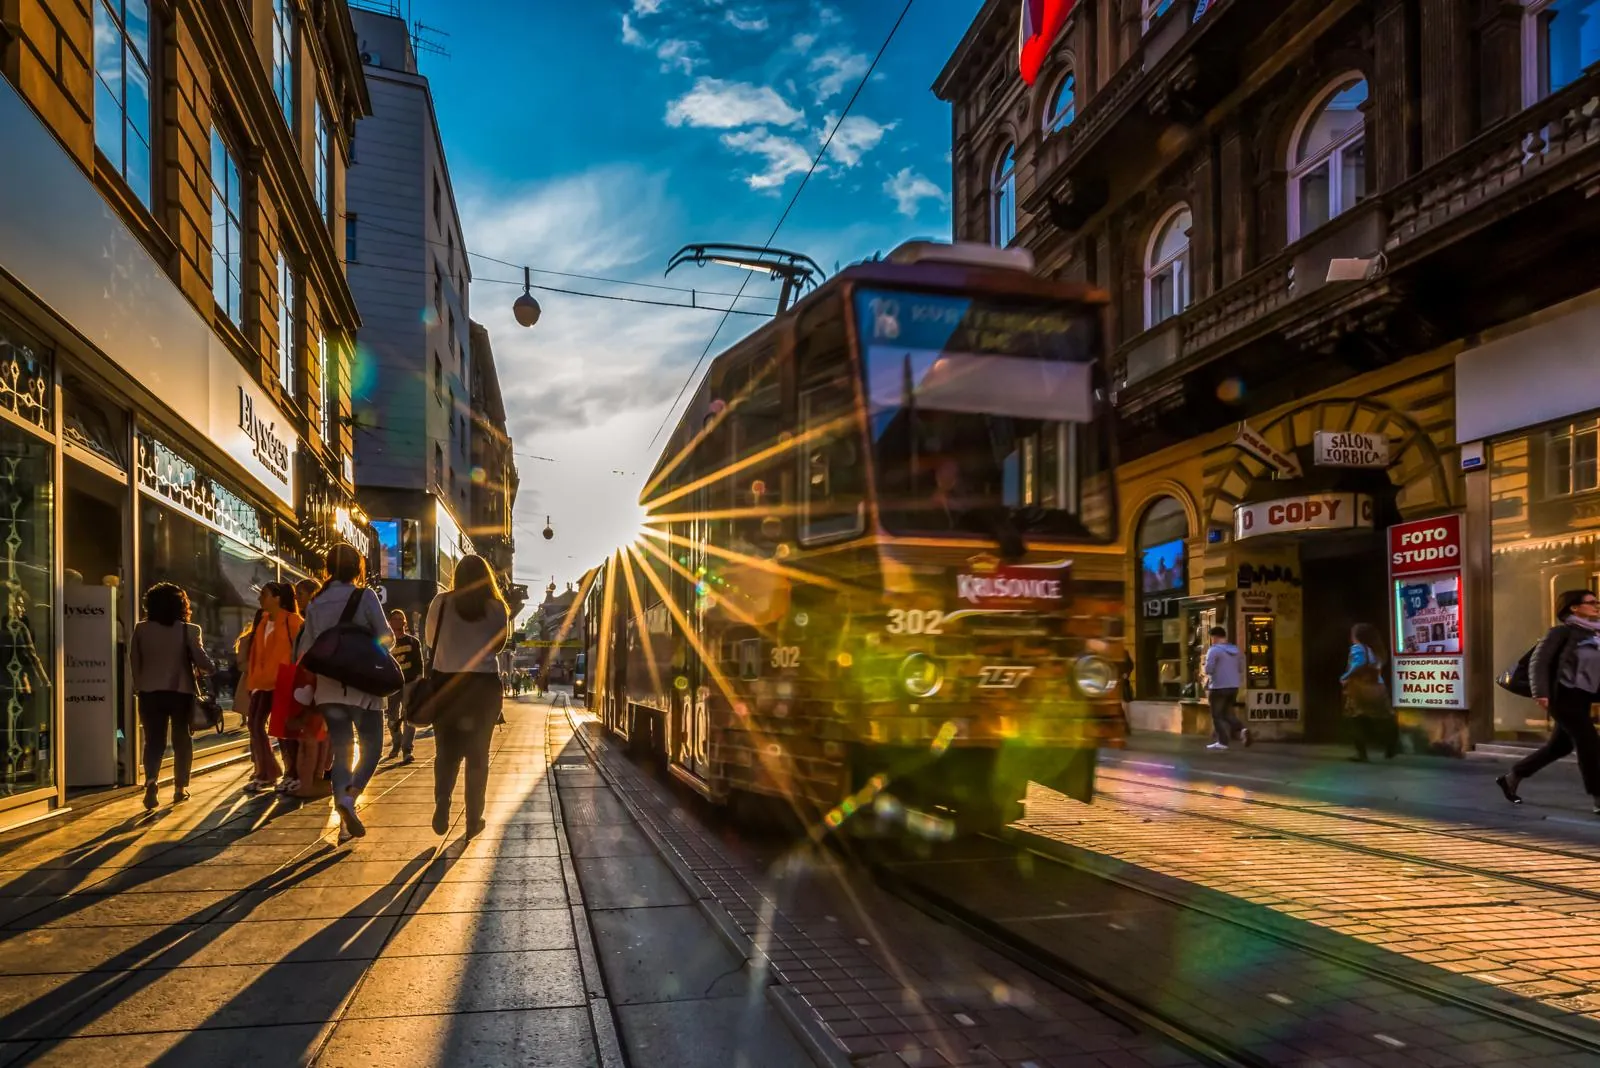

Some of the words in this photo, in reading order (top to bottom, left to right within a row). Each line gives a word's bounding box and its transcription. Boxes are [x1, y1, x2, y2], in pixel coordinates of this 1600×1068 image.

[238, 385, 289, 471] Elysées
[1331, 433, 1373, 451] SALON
[1326, 448, 1380, 465] TORBICA
[1268, 499, 1342, 526] COPY
[1401, 527, 1448, 546] FOTO
[1393, 544, 1459, 564] STUDIO
[64, 603, 105, 618] lysées
[886, 608, 944, 635] 302
[770, 646, 800, 668] 302
[1397, 670, 1436, 681] TISAK
[1440, 670, 1460, 681] NA
[1403, 683, 1454, 694] MAJICE
[1256, 692, 1290, 705] FOTO
